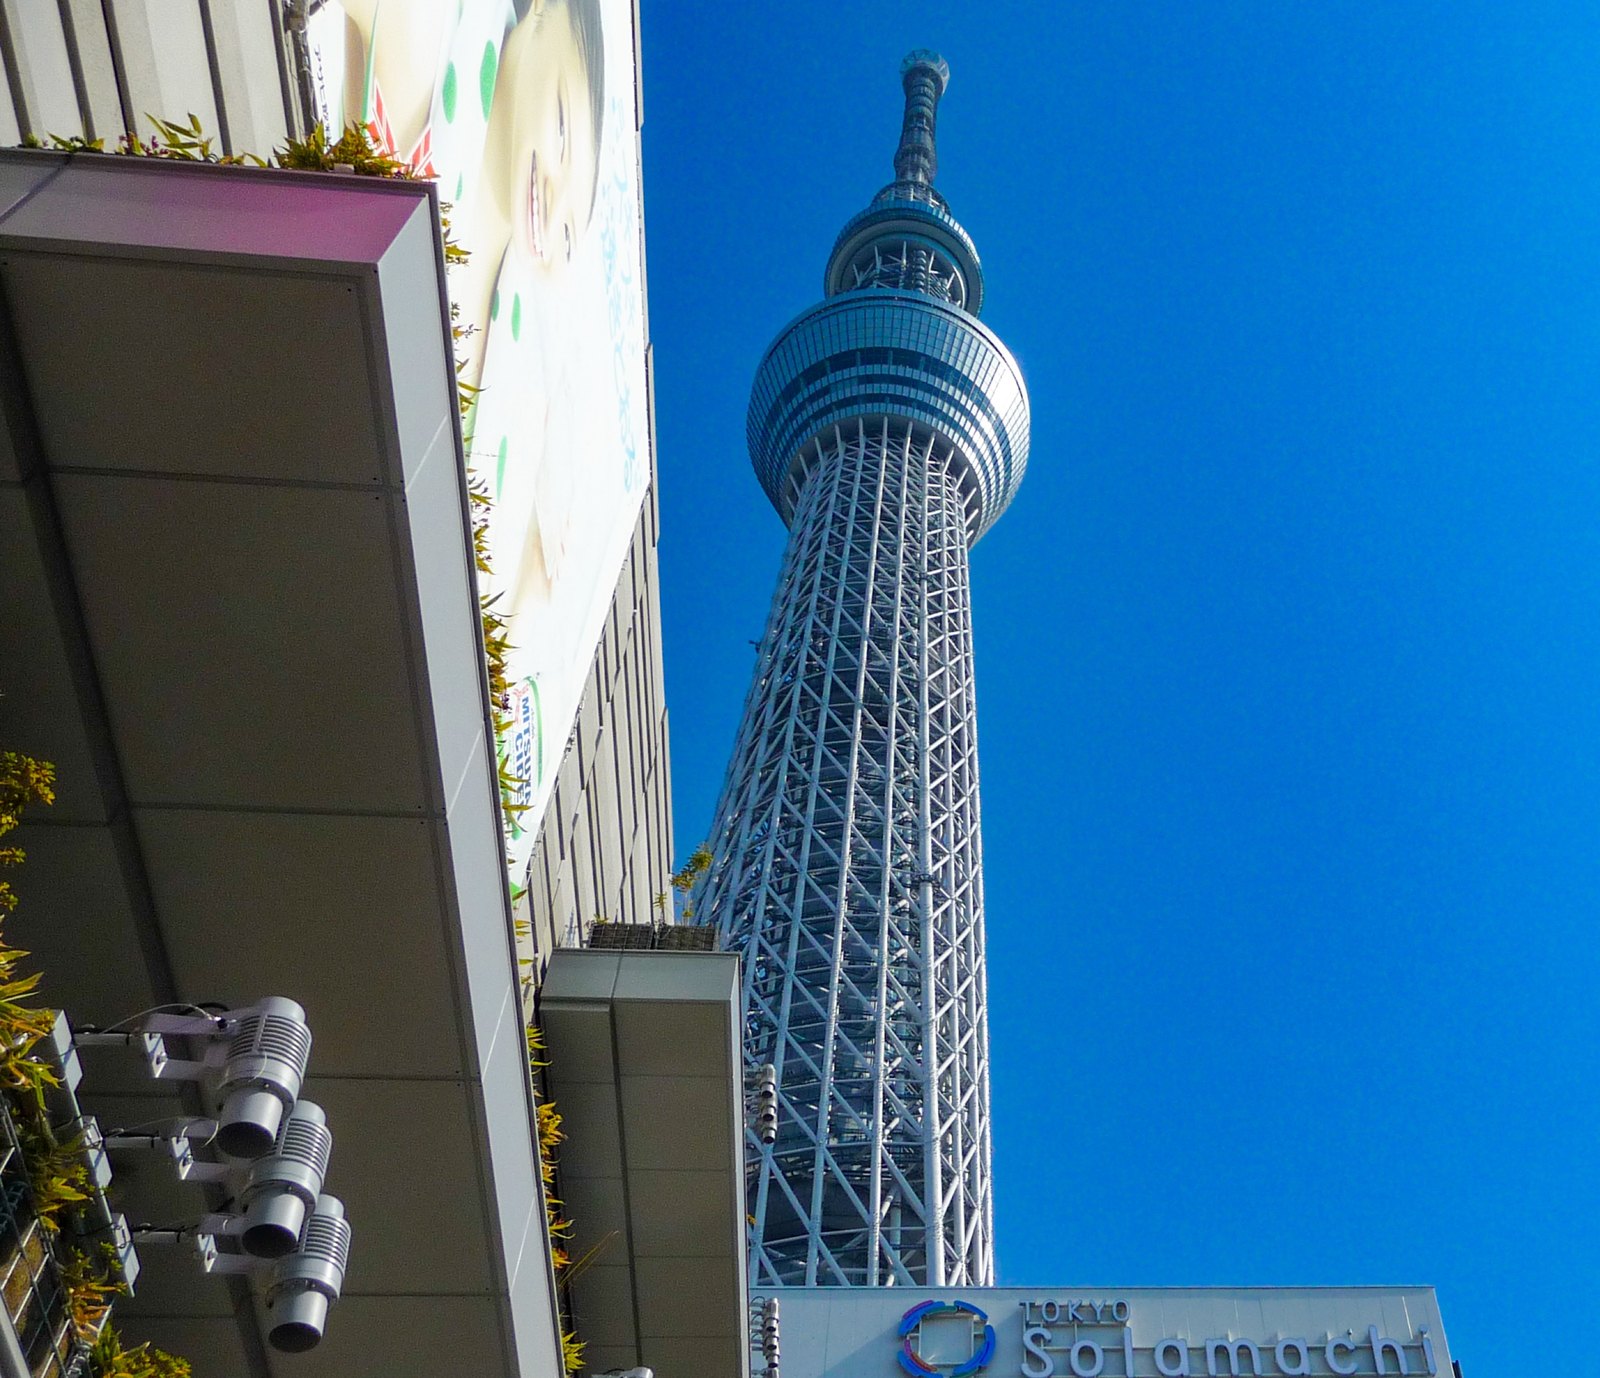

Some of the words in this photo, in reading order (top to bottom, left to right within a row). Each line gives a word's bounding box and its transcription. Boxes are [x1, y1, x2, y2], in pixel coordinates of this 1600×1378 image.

[522, 696, 531, 804] MITSUYA
[1019, 1299, 1131, 1323] TOKYO
[1021, 1324, 1437, 1378] Solamachi
